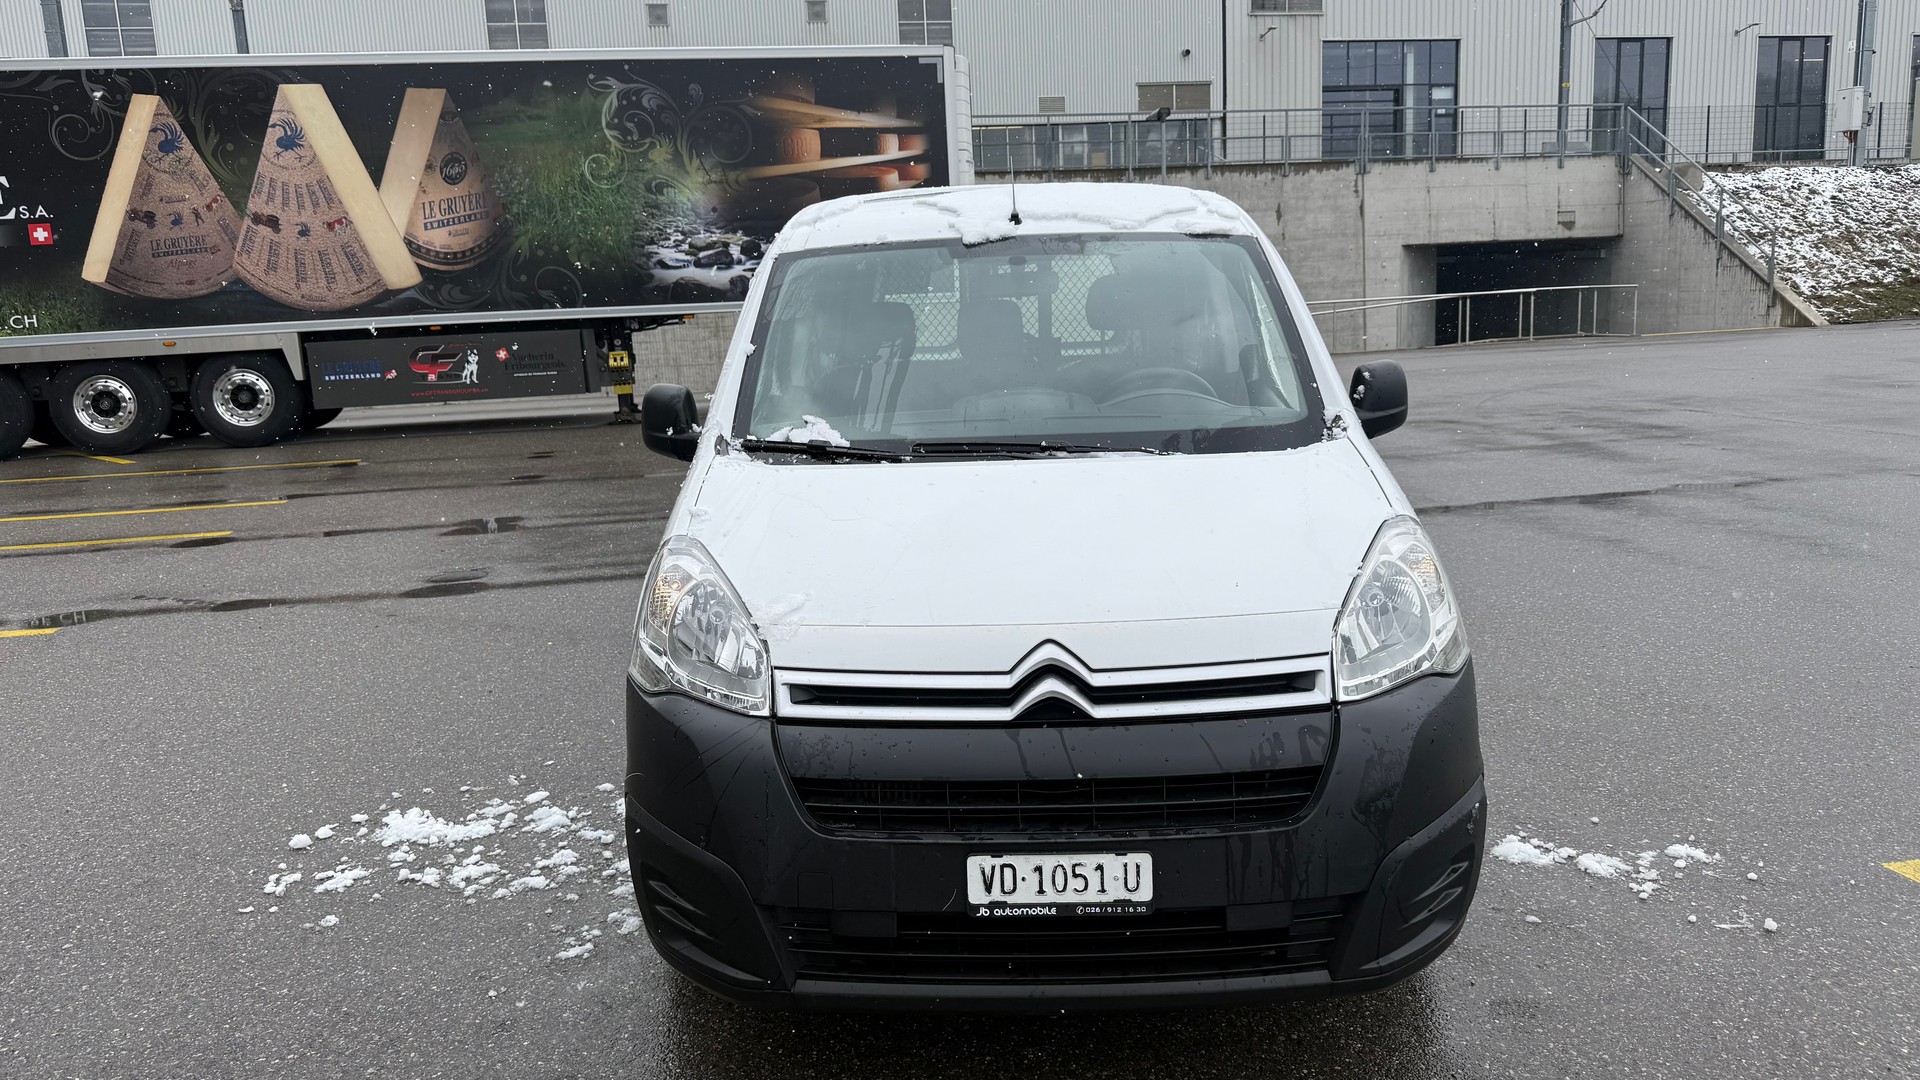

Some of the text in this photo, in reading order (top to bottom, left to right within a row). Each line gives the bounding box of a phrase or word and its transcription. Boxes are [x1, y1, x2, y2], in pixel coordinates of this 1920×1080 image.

[19, 204, 54, 219] S.A.
[422, 190, 488, 220] LE GRUYÈRE
[424, 212, 489, 231] SWITZERLAND
[150, 239, 162, 251] LE
[164, 233, 208, 250] GRUYÈRE
[994, 906, 1056, 916] automobile
